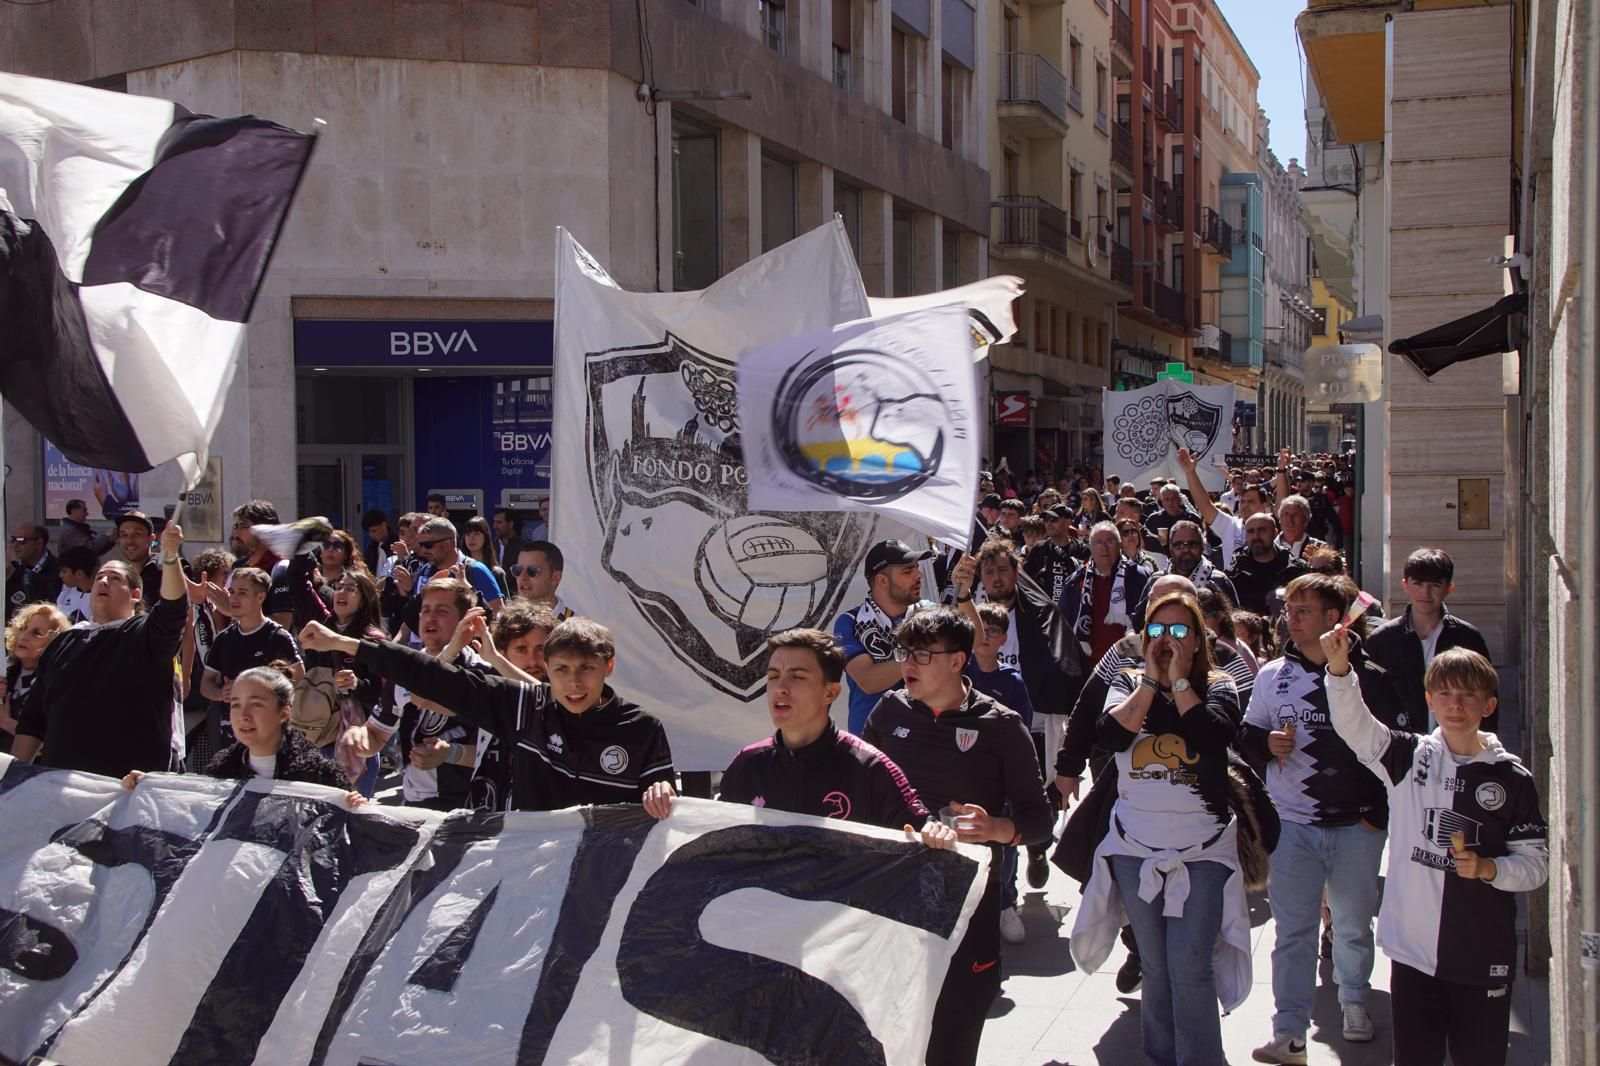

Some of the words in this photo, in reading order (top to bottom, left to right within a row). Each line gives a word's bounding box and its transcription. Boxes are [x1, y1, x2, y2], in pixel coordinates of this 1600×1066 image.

[390, 329, 478, 356] BBVA
[501, 432, 552, 451] BBVA
[510, 458, 534, 466] Oficina
[47, 464, 58, 476] de
[58, 464, 65, 476] la
[67, 464, 92, 476] banca
[501, 468, 523, 476] Digital
[632, 455, 712, 484] FONDO
[187, 493, 214, 505] BBVA
[1303, 710, 1326, 722] Don
